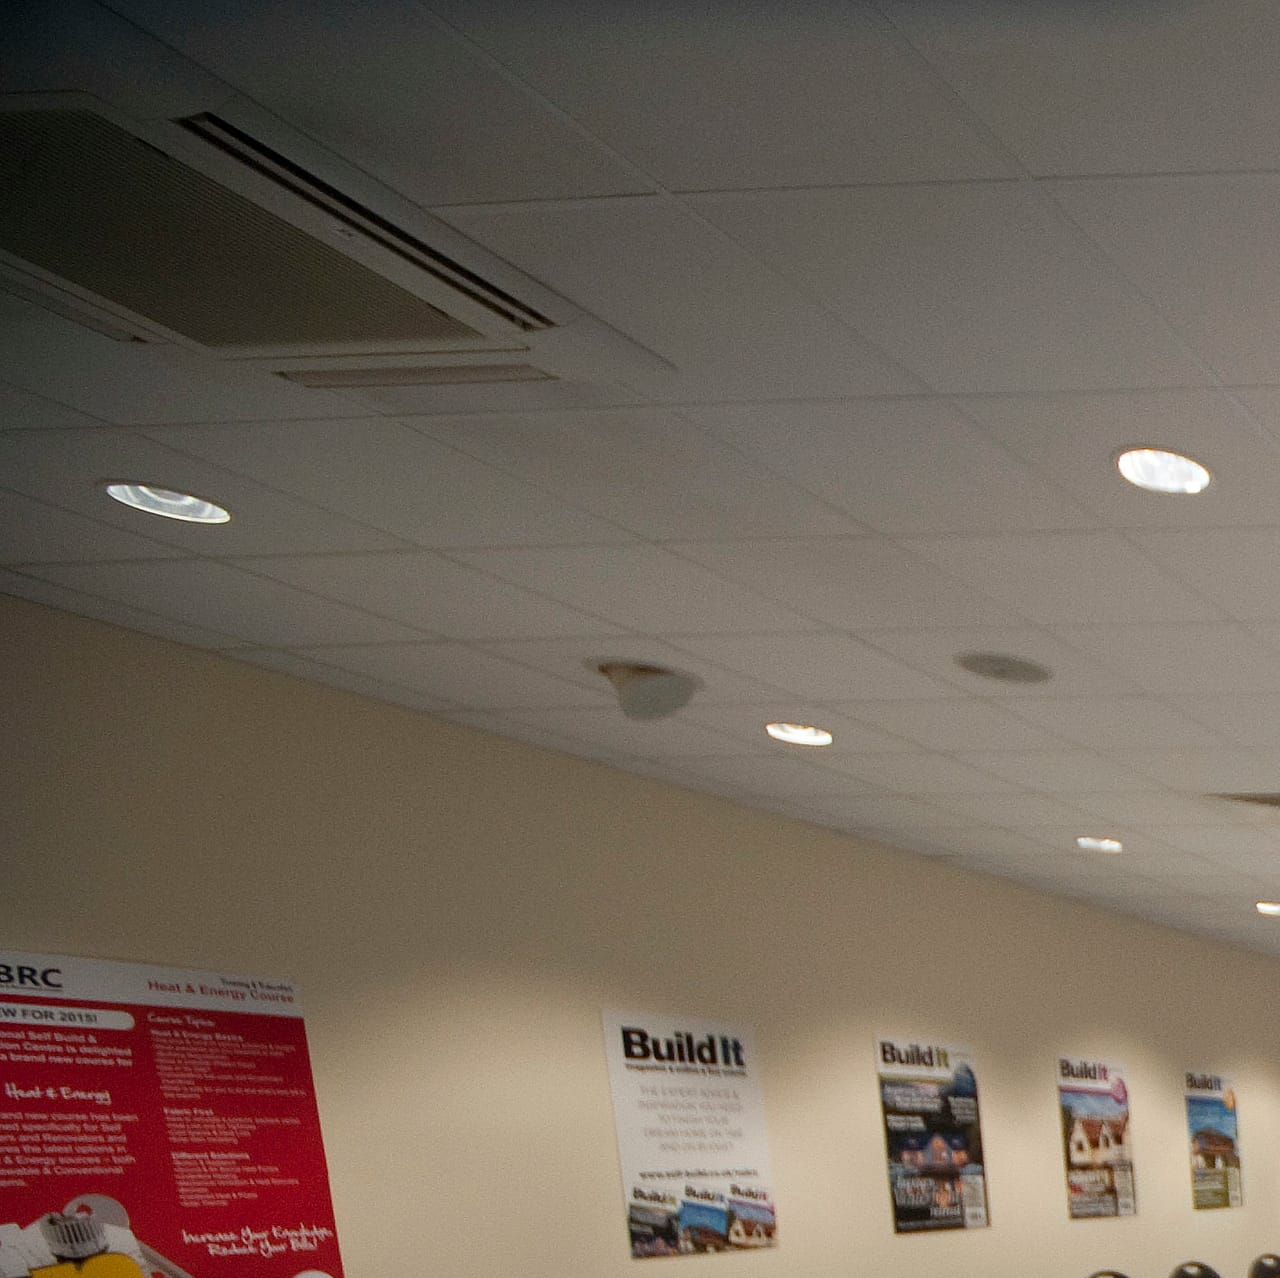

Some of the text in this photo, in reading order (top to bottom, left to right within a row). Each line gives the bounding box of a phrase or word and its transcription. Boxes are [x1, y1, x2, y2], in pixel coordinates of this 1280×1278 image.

[147, 981, 295, 1003] Heat & Energy Course
[21, 1010, 55, 1021] FOR
[621, 1024, 746, 1067] Build It
[881, 1041, 935, 1068] Build
[1060, 1058, 1097, 1080] Build
[1186, 1071, 1213, 1090] Build
[5, 1081, 44, 1101] Heat
[60, 1085, 112, 1106] Energy
